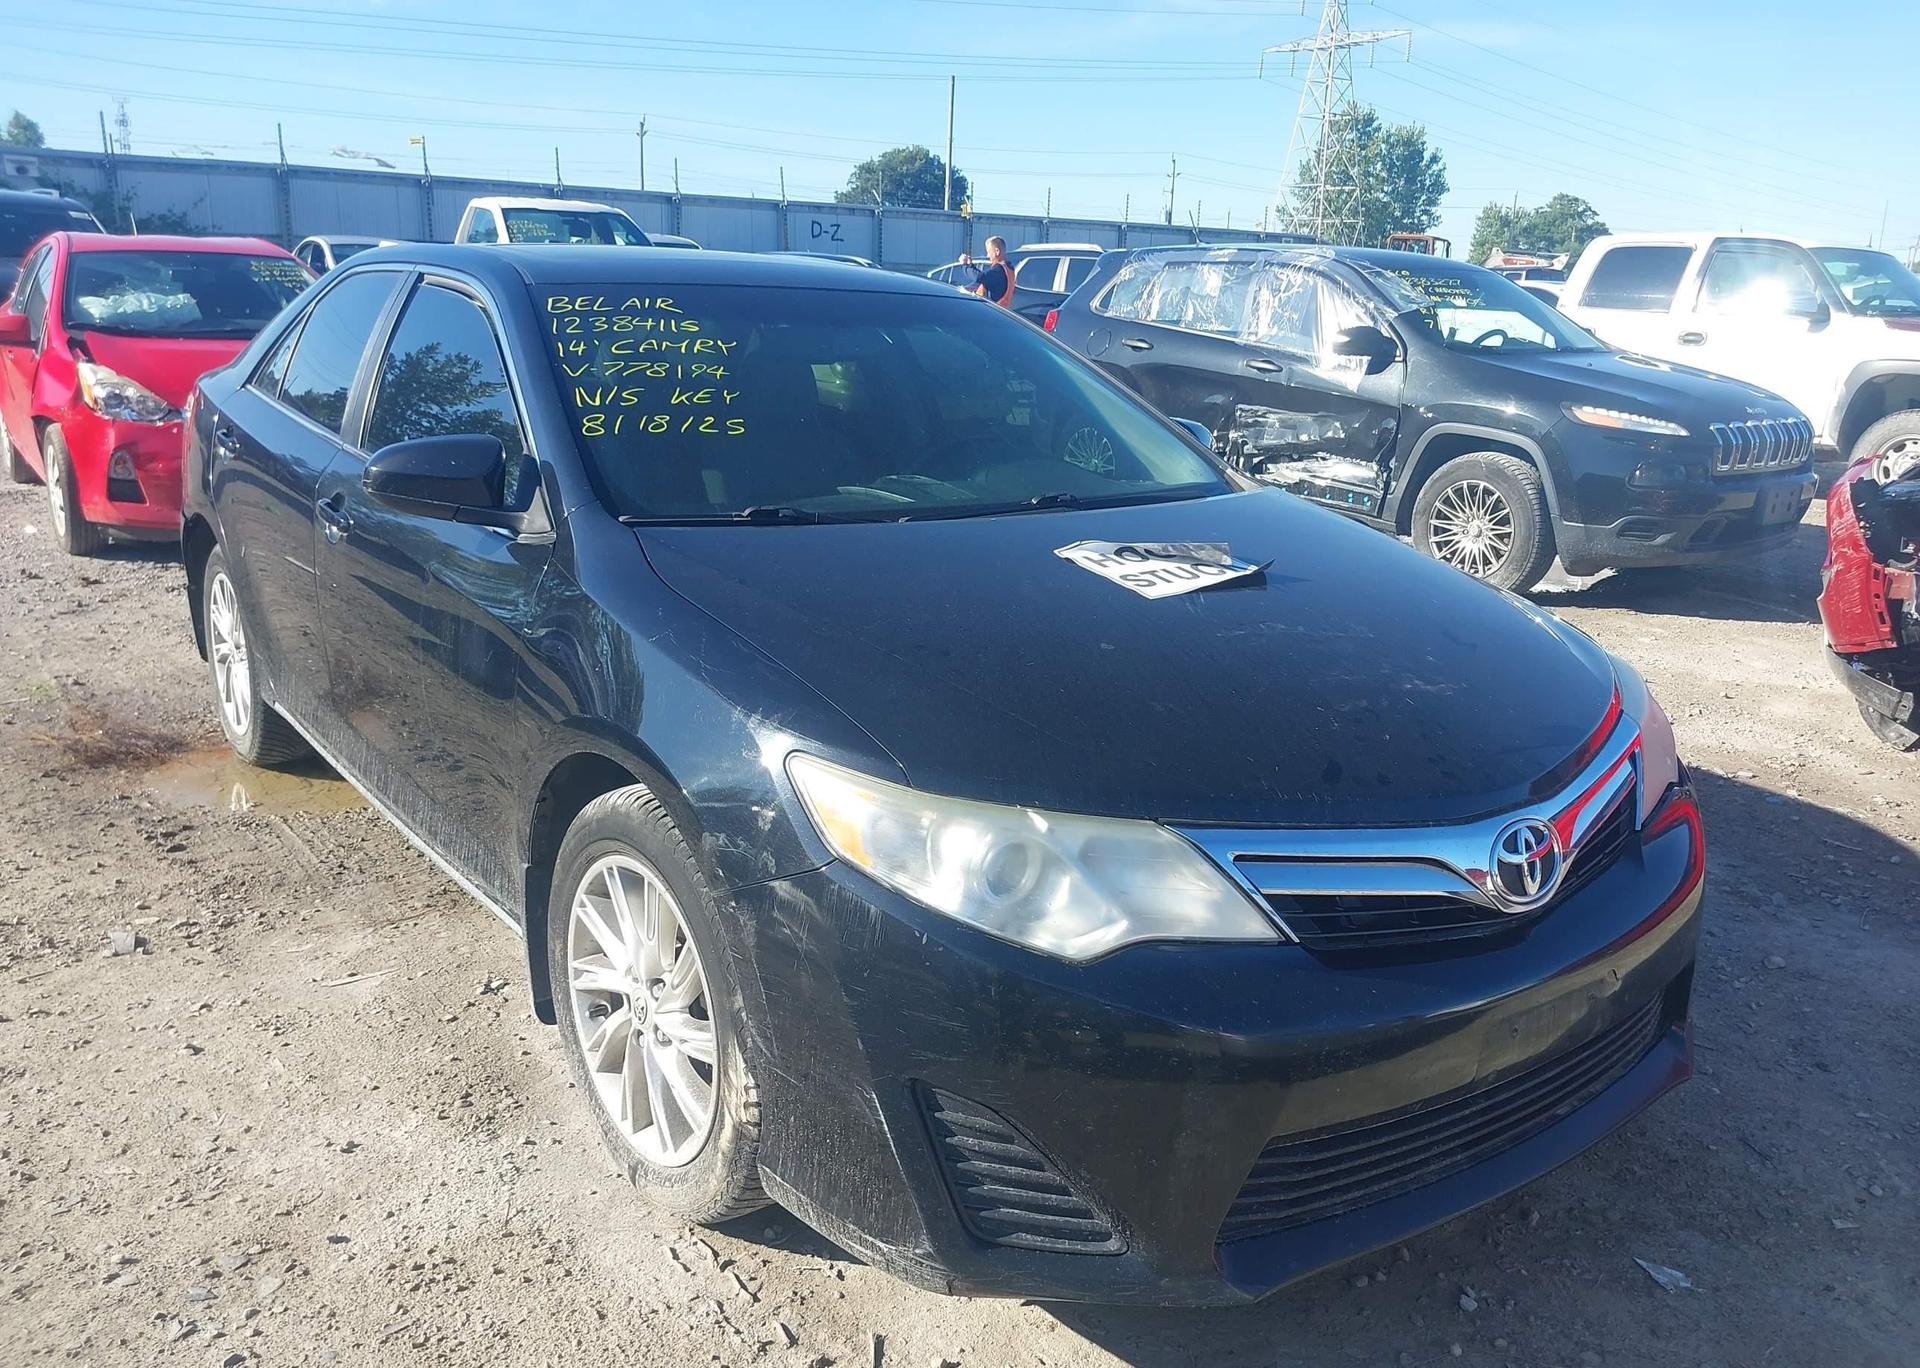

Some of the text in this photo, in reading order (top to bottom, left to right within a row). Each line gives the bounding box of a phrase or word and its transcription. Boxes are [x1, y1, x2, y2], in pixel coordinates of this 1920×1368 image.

[552, 316, 700, 334] 12384115
[611, 339, 737, 356] CAMRY
[562, 362, 730, 379] V-778194
[575, 386, 740, 407] N/S KEY
